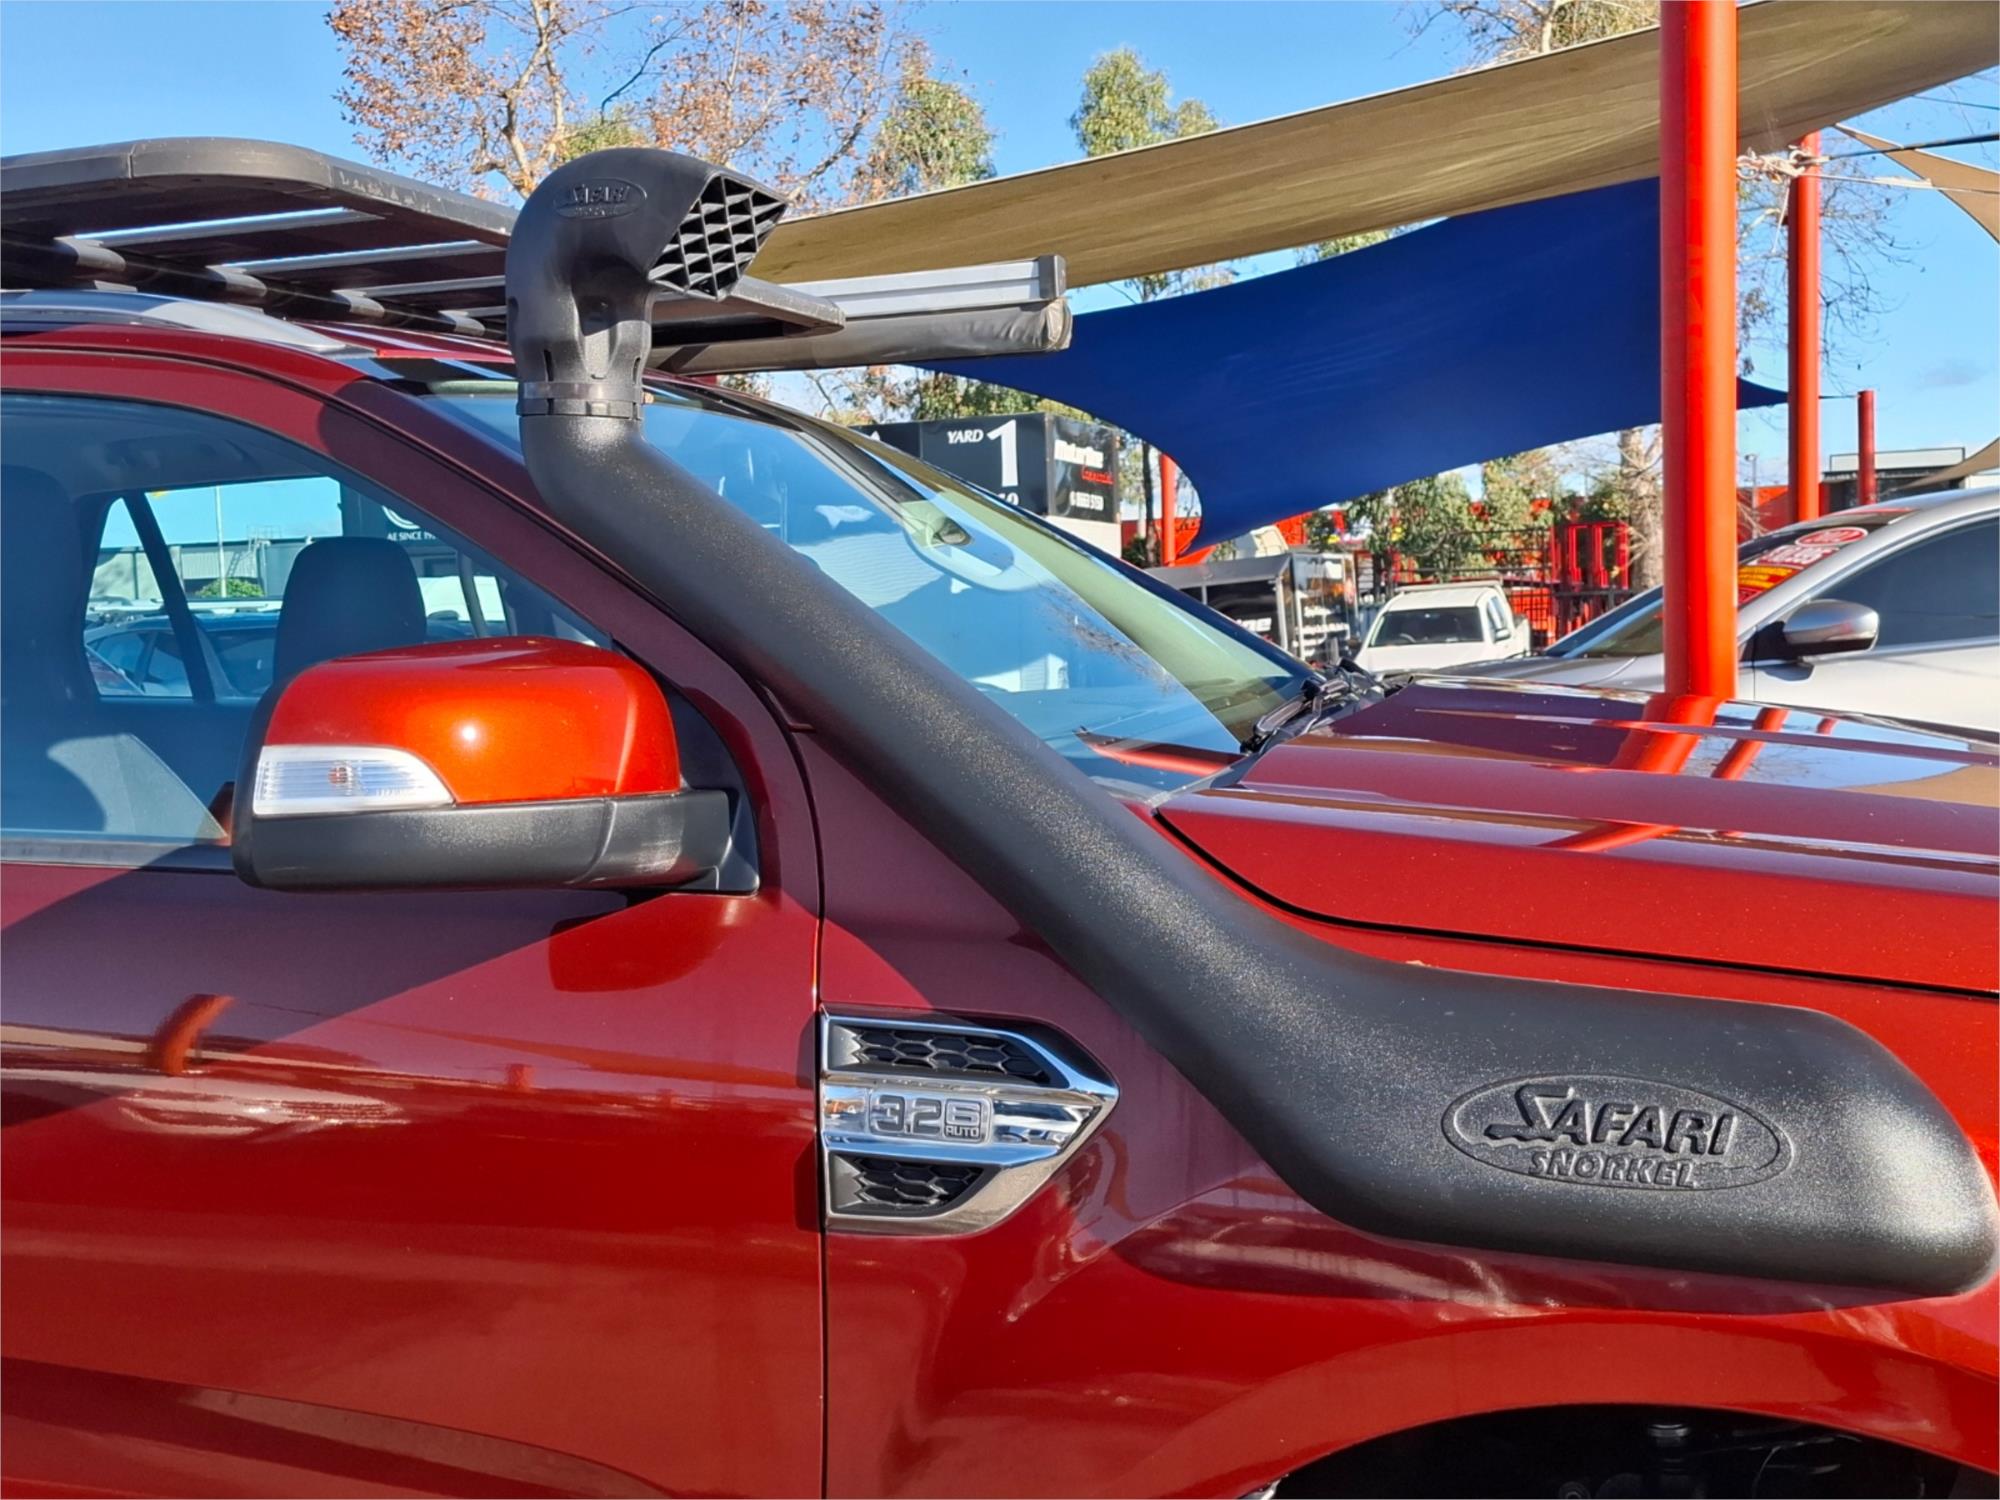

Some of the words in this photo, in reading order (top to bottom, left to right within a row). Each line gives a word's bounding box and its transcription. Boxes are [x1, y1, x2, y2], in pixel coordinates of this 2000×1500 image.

[947, 429, 984, 444] YARD
[987, 419, 1018, 487] 1
[945, 1125, 980, 1138] AUTO
[1484, 1083, 1737, 1156] SAFARI
[1528, 1149, 1698, 1189] SNORKEL
